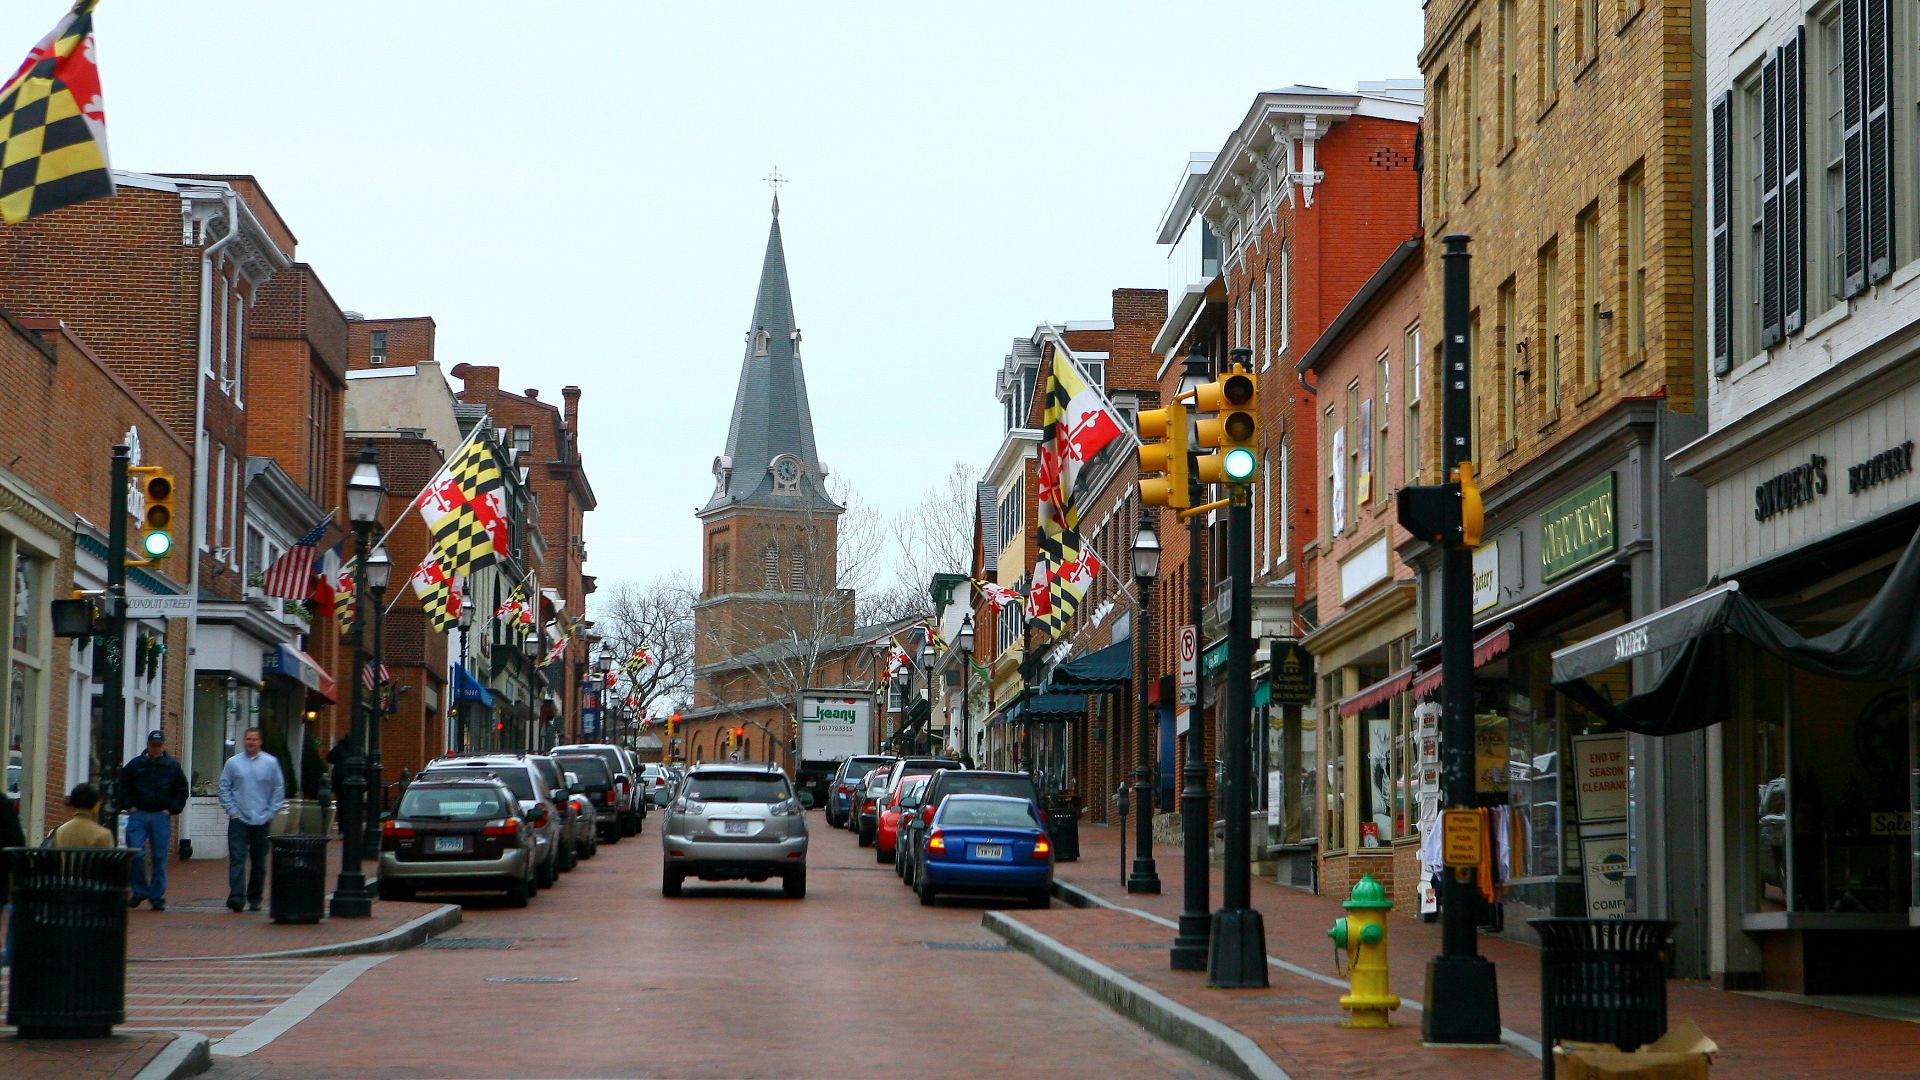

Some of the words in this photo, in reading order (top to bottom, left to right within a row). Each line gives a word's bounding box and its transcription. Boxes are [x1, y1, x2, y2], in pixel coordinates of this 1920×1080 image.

[1754, 453, 1828, 522] SNYDER'S
[1847, 440, 1914, 495] BOOTERY
[127, 598, 164, 609] CONDUIT
[163, 598, 193, 609] STREET
[816, 706, 856, 724] keany
[1589, 752, 1608, 763] END
[1609, 751, 1621, 762] OF
[1588, 767, 1625, 778] SEASON
[1874, 814, 1911, 832] Sale
